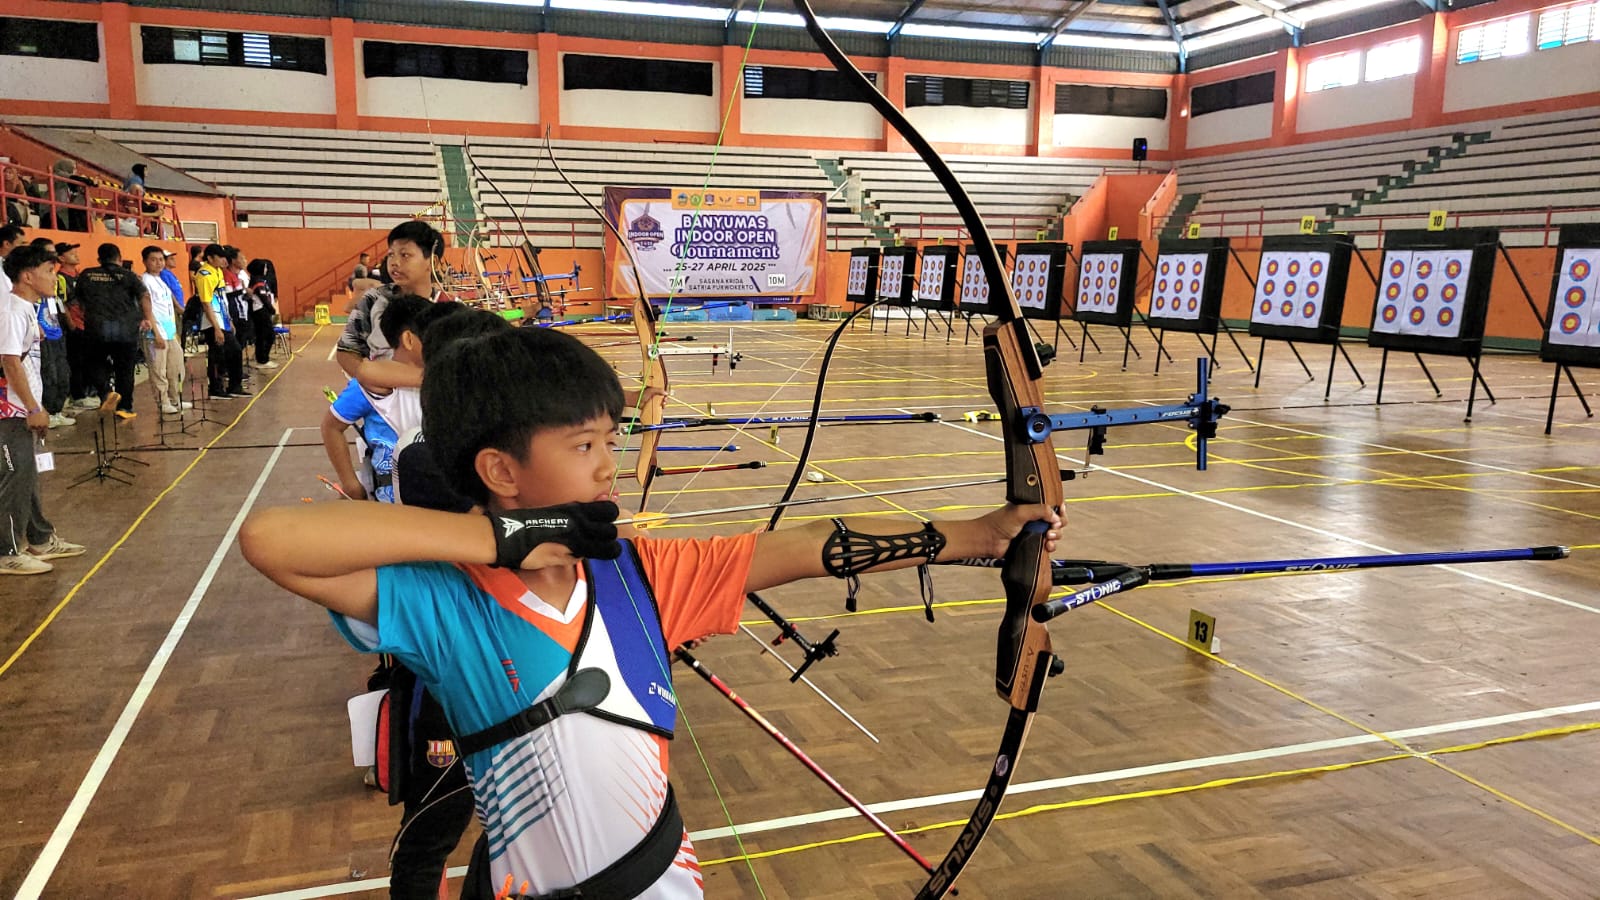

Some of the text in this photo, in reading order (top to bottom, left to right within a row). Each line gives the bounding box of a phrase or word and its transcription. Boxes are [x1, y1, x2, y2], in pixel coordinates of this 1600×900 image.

[683, 215, 766, 229] BANYUMAS
[1303, 219, 1313, 230] 09
[1433, 215, 1443, 226] 10
[650, 231, 664, 239] OPEN
[676, 230, 775, 243] INDOOR OPEN
[671, 243, 779, 258] Tournament
[674, 262, 766, 271] 25-27 APRIL 2025
[669, 279, 683, 287] 7M
[769, 276, 785, 285] 10M
[525, 518, 569, 526] ARCHERY
[1075, 580, 1121, 605] STONIC
[1194, 620, 1208, 643] 13
[929, 797, 992, 895] SIRIUS
